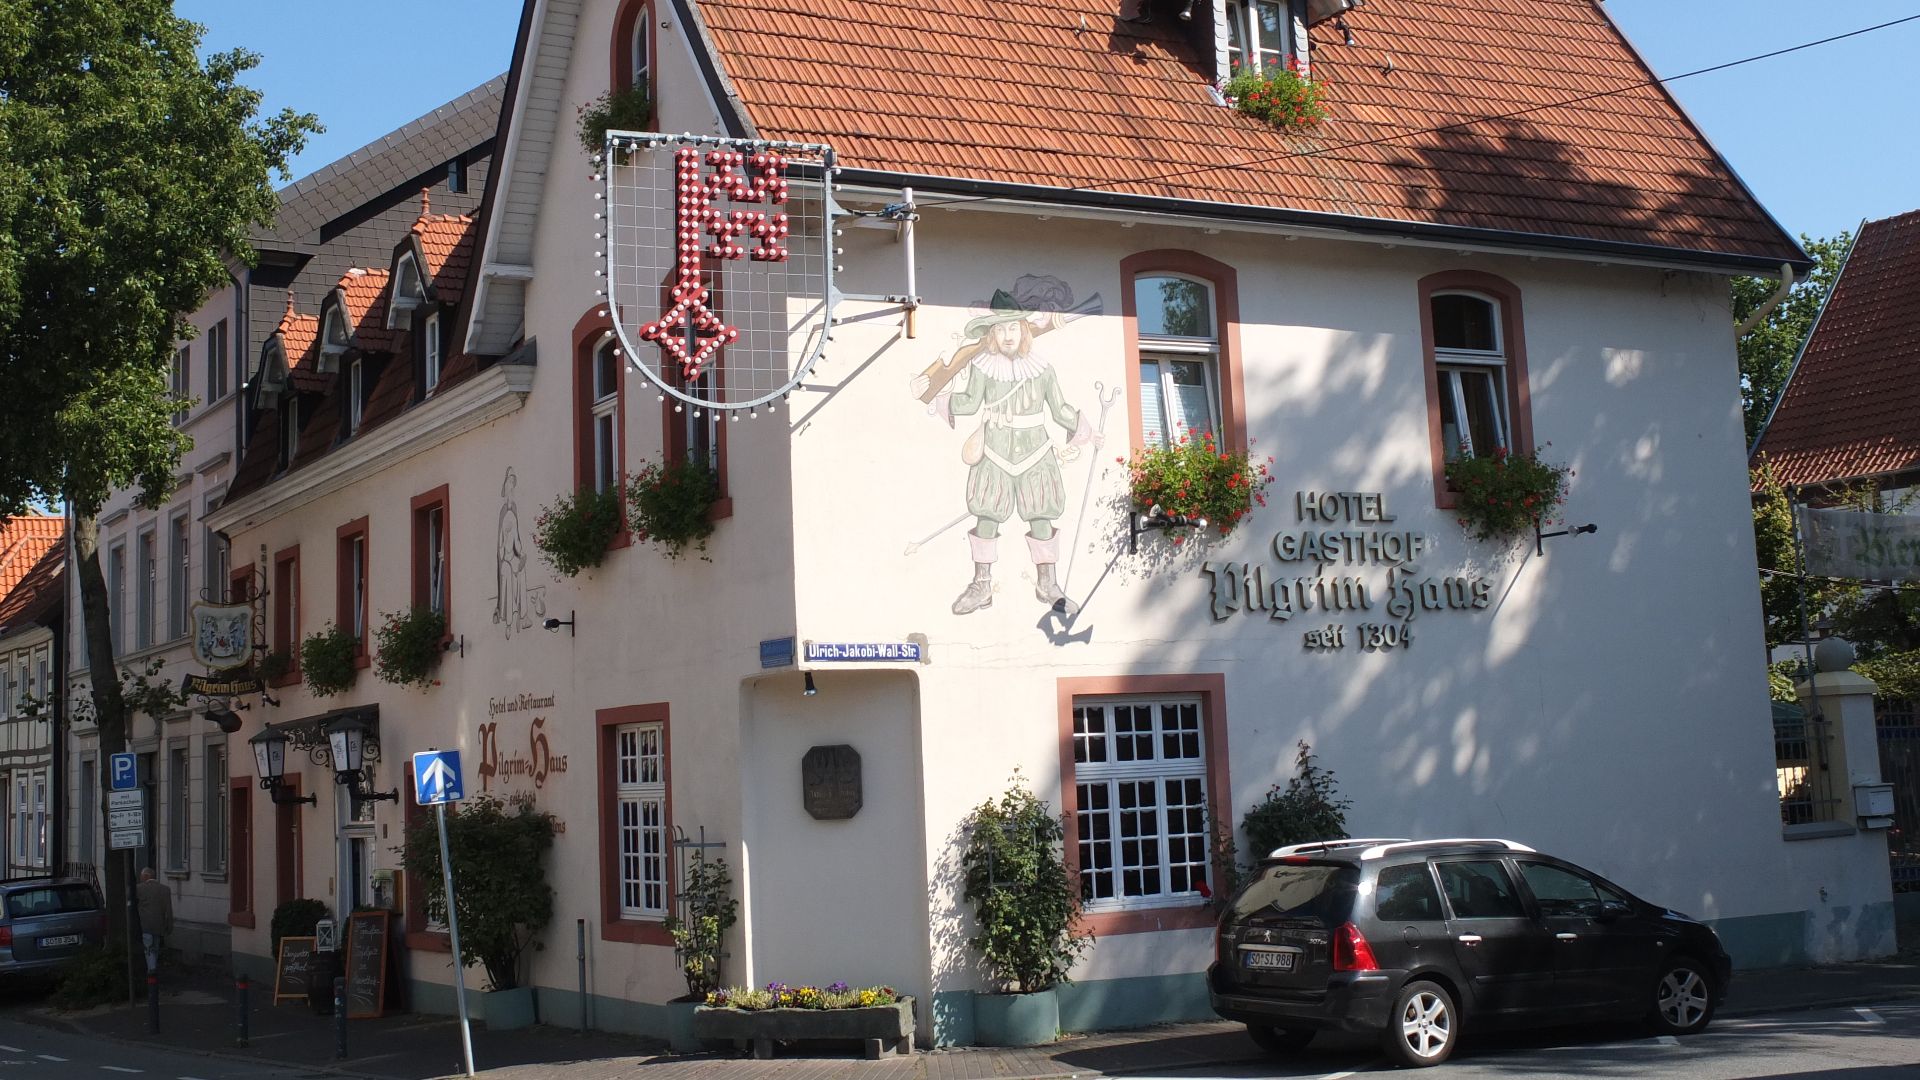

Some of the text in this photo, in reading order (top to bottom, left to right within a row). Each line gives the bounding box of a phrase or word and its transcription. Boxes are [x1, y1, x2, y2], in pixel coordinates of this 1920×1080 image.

[1297, 491, 1396, 521] HOTEL
[1274, 531, 1424, 562] GASTHOF
[1202, 560, 1495, 622] Pilgrim Haus
[1304, 622, 1414, 649] seit 1304
[808, 644, 917, 658] Ulrich-Jakobi-Wall-Str.
[489, 690, 555, 719] Hotel und Restaurant
[115, 757, 132, 781] P
[1250, 953, 1291, 966] SO SI 988
